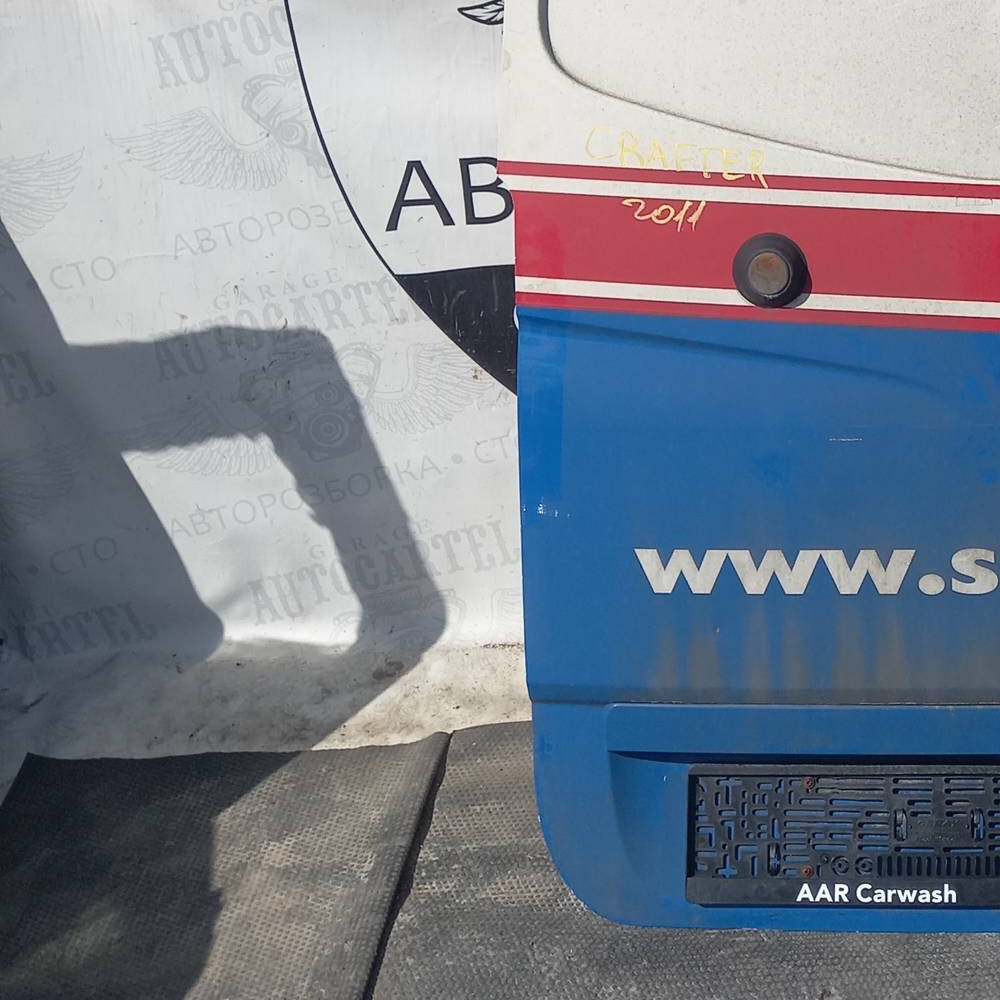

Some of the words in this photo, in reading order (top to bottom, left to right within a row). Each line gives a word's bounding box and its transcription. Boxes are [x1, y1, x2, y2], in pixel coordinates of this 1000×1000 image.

[584, 123, 769, 188] CRAFTER
[48, 255, 118, 293] СТО
[473, 429, 517, 464] СТ
[49, 536, 118, 576] СТО
[796, 883, 849, 903] AAR
[856, 883, 958, 904] Carwash
